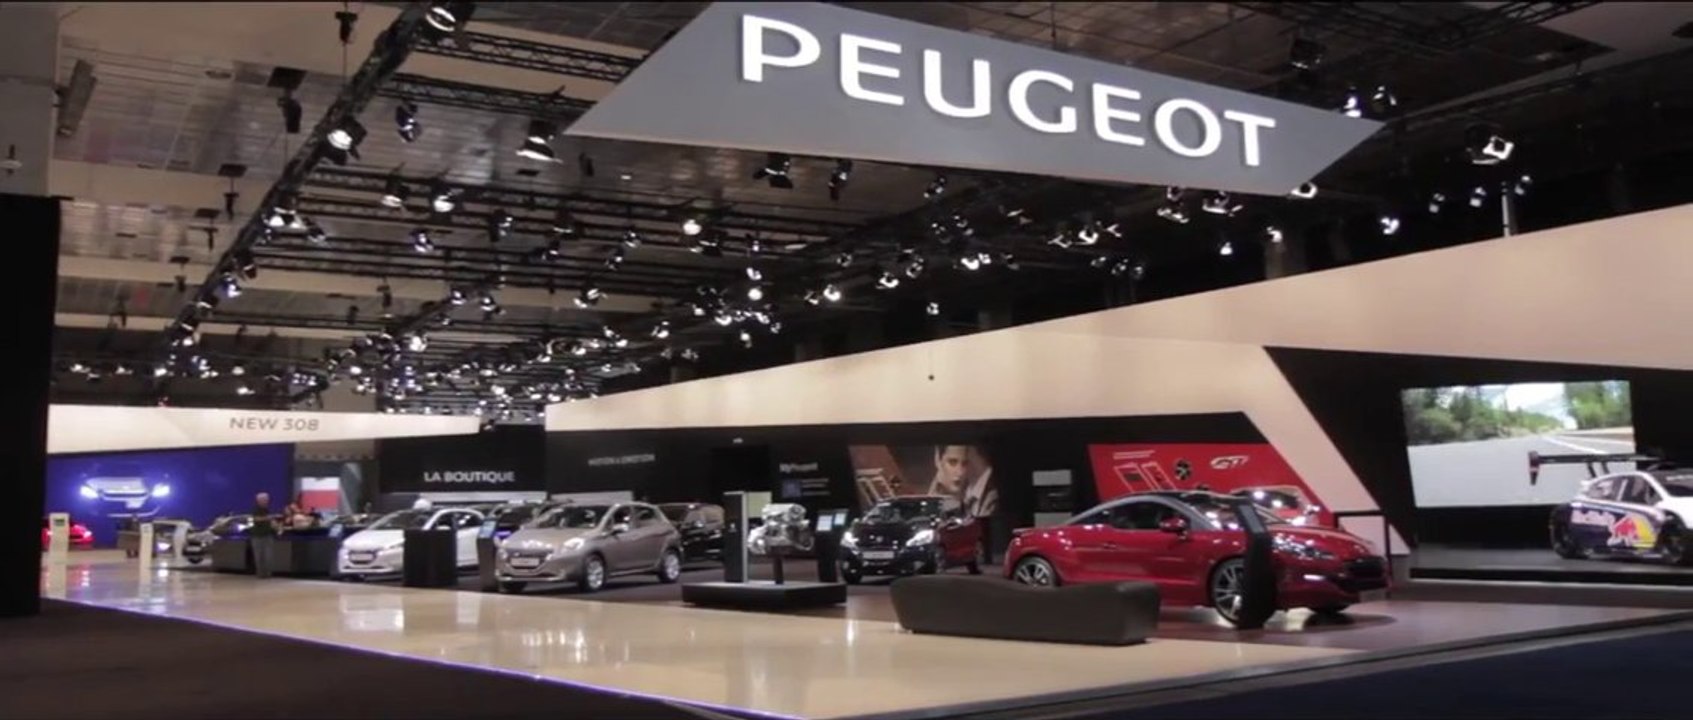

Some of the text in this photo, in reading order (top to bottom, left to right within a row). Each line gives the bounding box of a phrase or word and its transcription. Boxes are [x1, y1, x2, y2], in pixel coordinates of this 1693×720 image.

[739, 14, 1276, 167] PEUGEOT
[229, 417, 320, 431] NEW 308
[423, 471, 515, 484] LA BOUTIQUE
